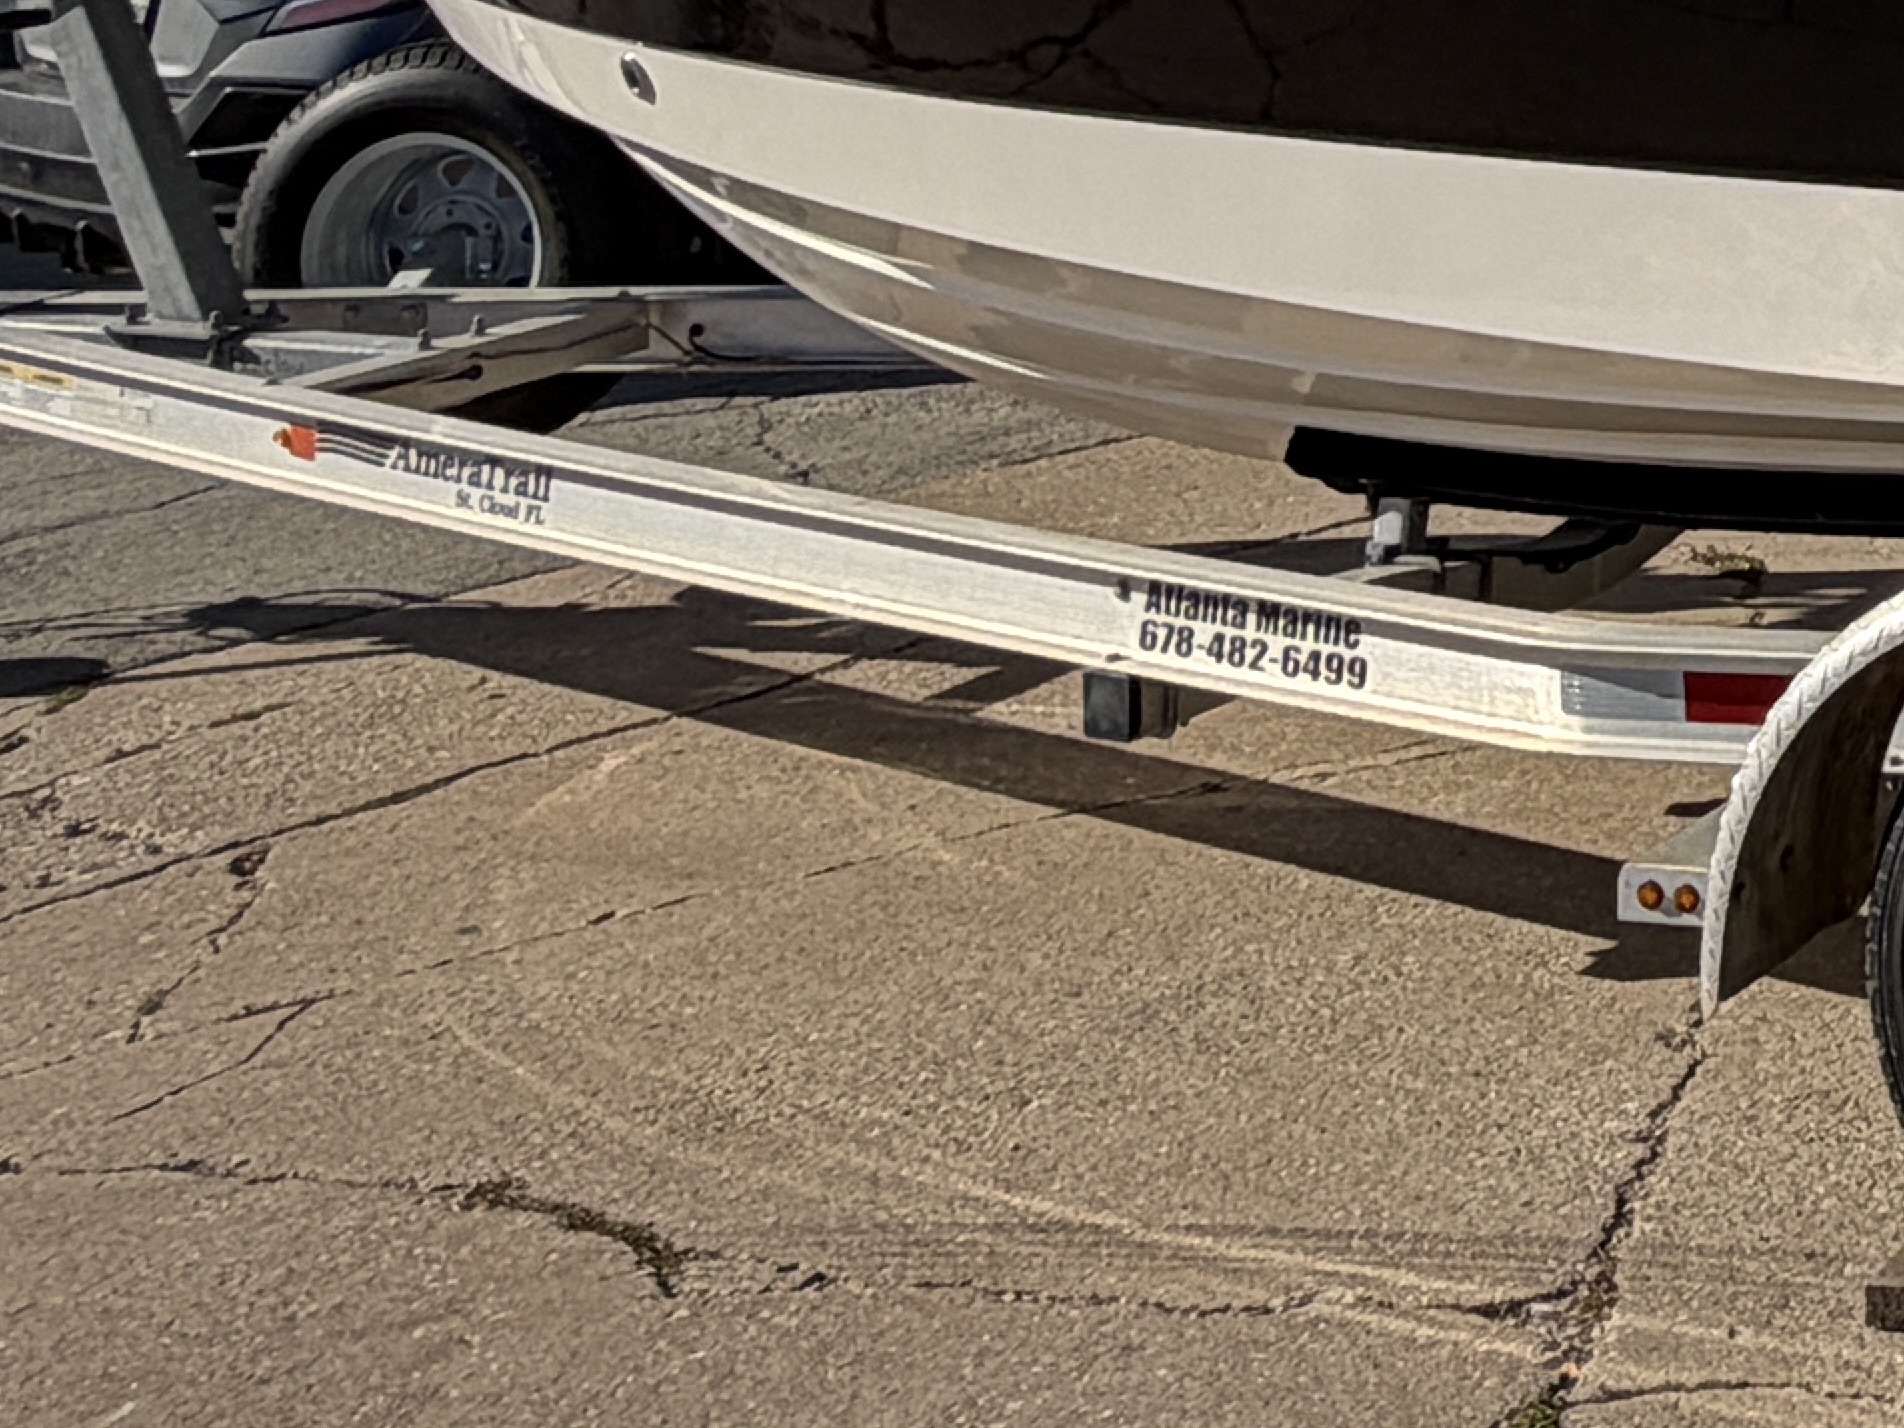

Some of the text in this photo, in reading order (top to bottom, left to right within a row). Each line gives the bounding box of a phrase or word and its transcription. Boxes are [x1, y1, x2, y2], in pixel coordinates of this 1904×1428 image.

[1145, 580, 1363, 650] Atlanta Marine
[1138, 619, 1369, 690] 678-482-6499
